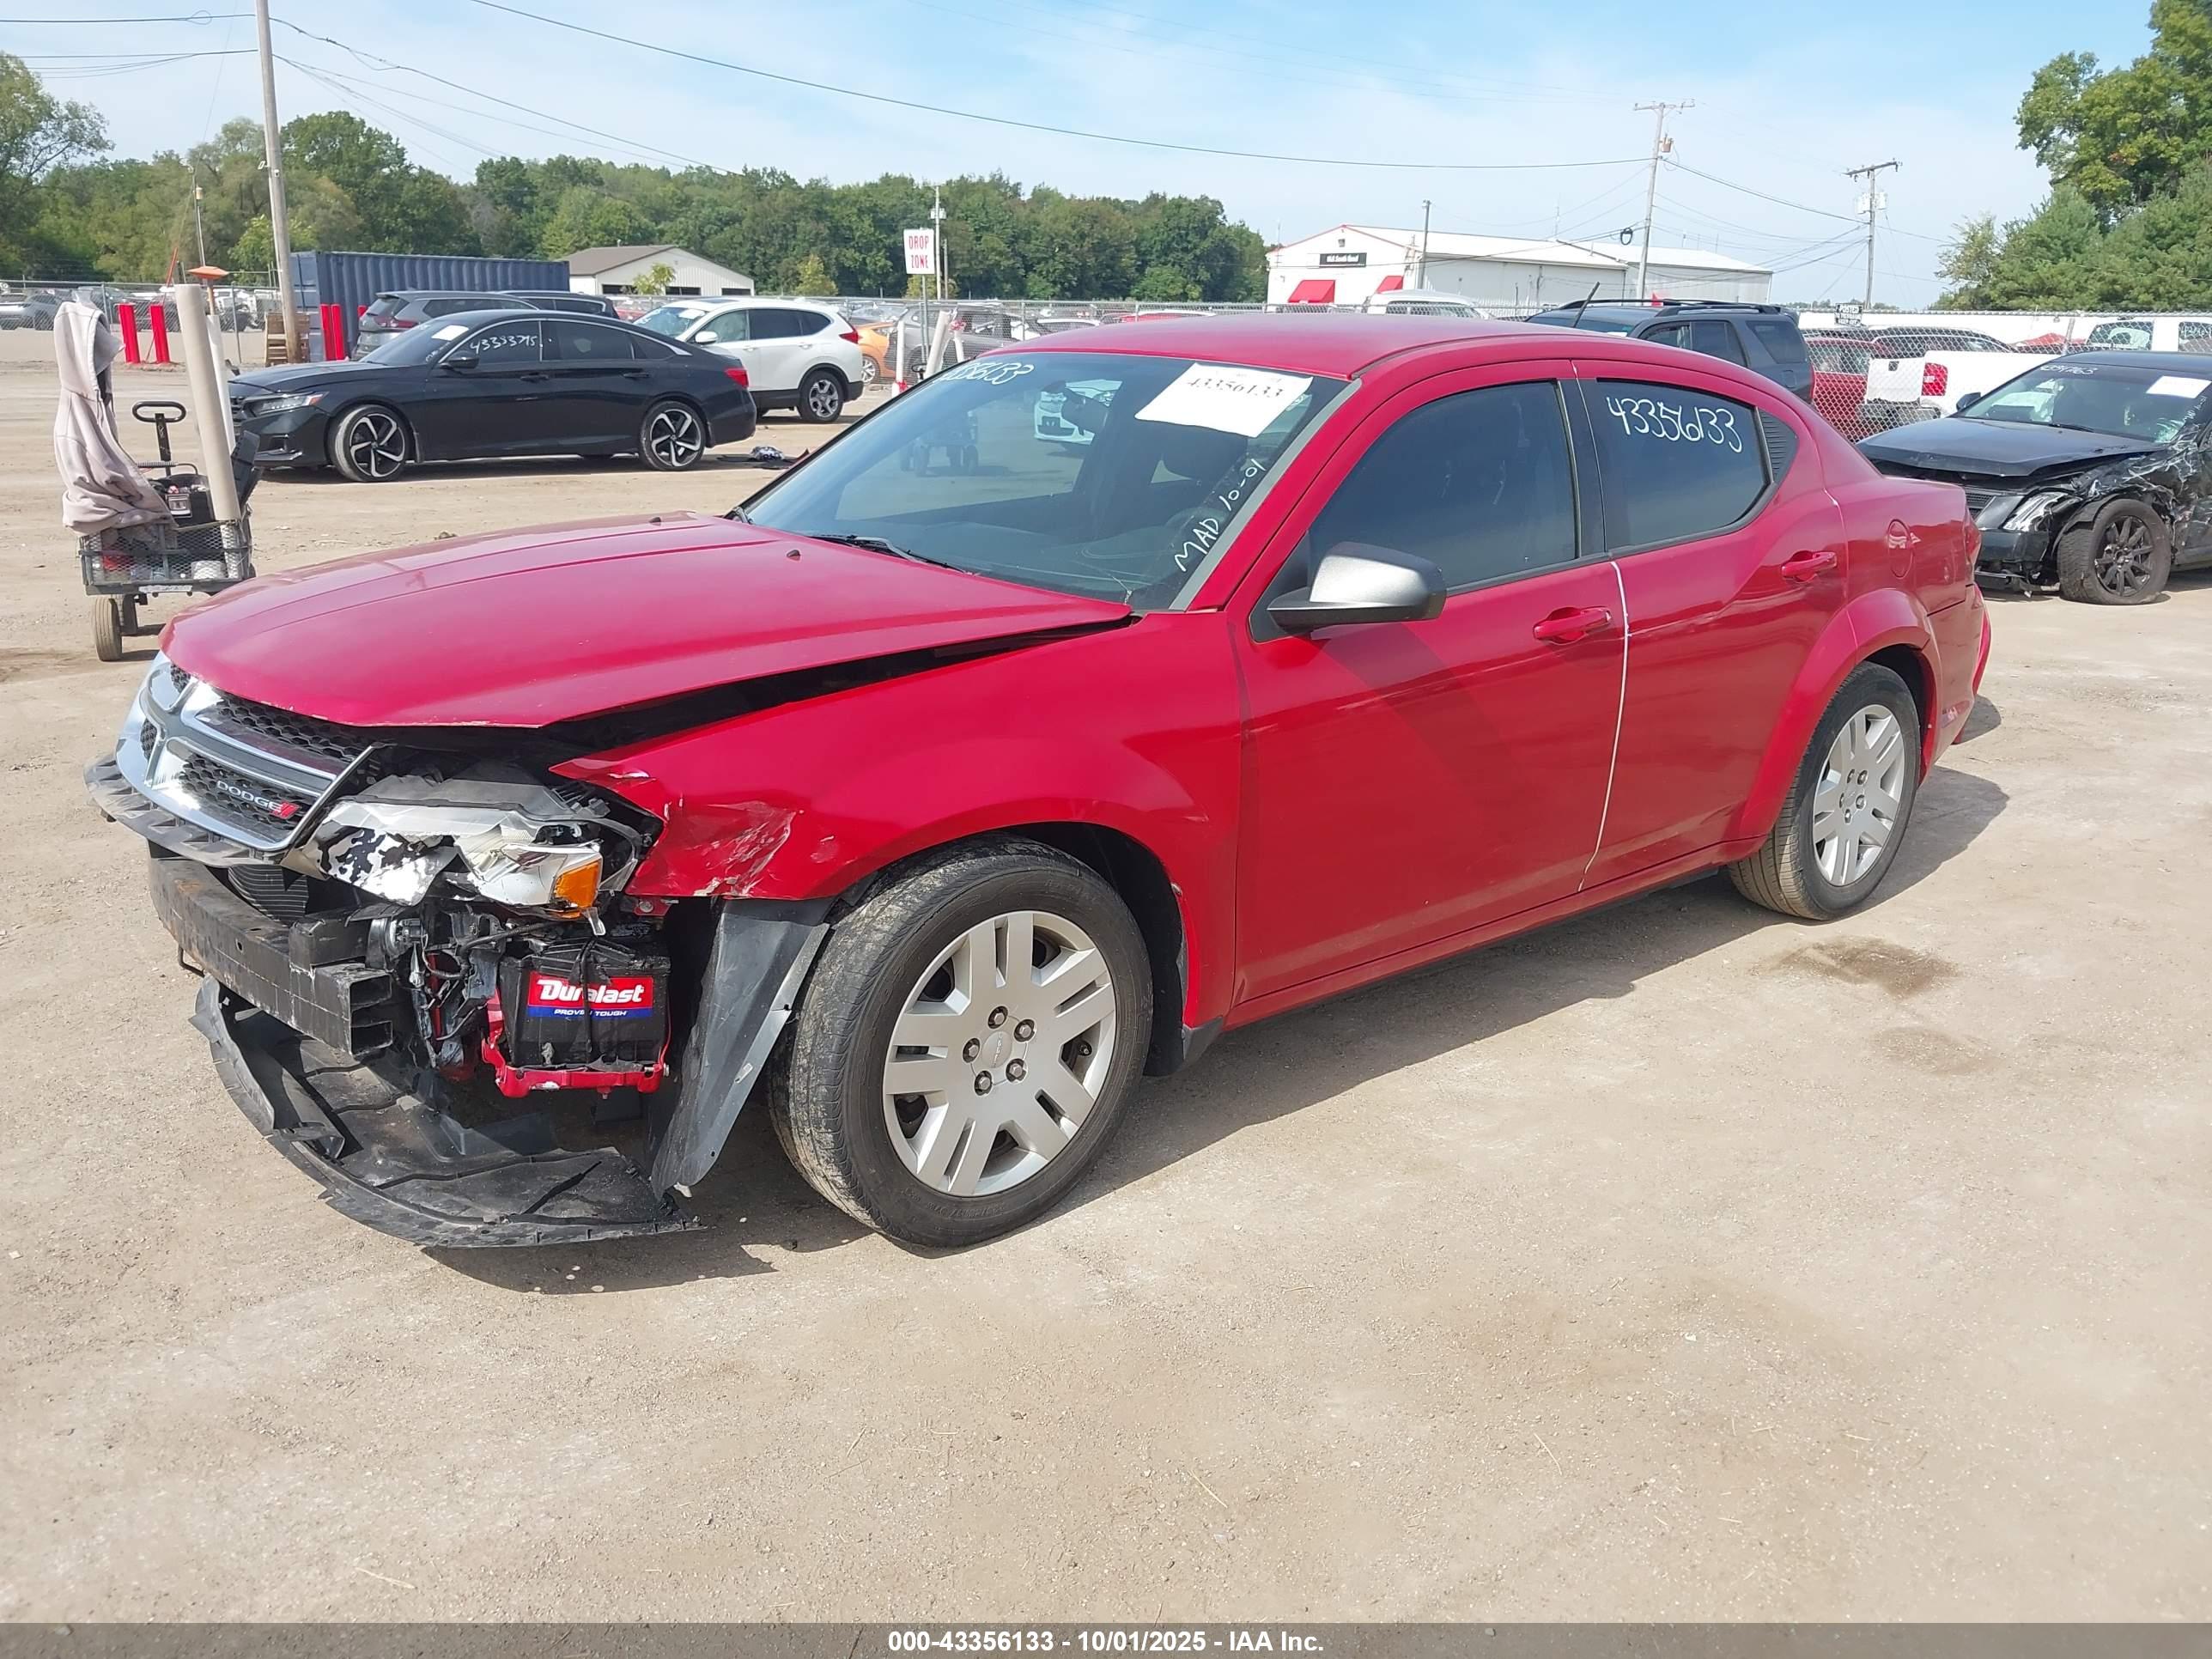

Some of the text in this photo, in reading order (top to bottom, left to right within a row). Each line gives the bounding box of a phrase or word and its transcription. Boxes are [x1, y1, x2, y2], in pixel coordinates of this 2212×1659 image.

[908, 235, 929, 249] DROP
[911, 254, 929, 269] ZONE
[1606, 396, 1743, 453] 43356133
[1174, 458, 1267, 573] MAD 10-01
[216, 780, 283, 813] DODGE
[537, 979, 645, 1004] Duralast
